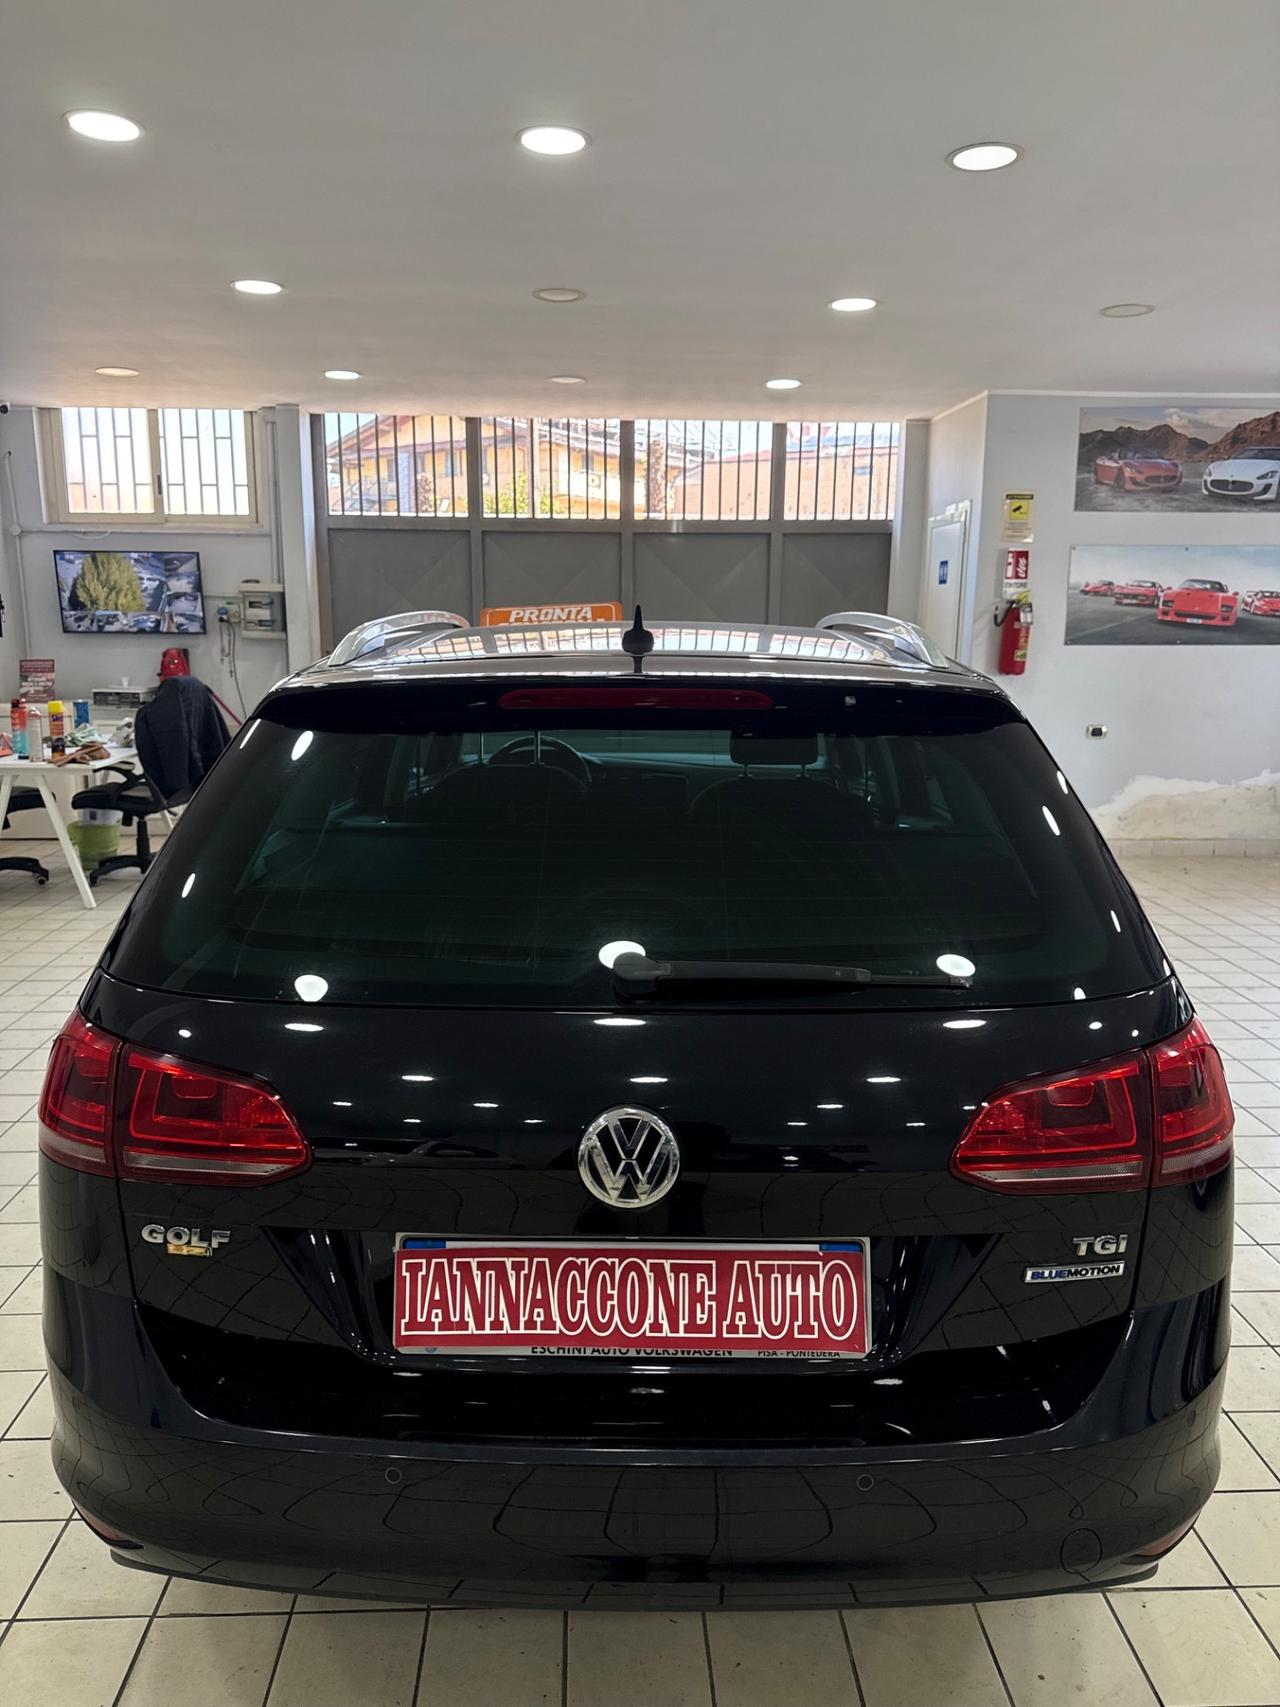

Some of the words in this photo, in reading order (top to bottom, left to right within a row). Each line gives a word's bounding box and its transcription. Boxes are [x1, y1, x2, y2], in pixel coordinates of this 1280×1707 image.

[509, 606, 592, 623] PRONTA
[141, 1224, 231, 1249] GOLF
[1072, 1234, 1128, 1256] TGI
[1030, 1265, 1121, 1280] BLUEMOTION
[401, 1256, 717, 1338] IANNACCONE
[722, 1259, 858, 1341] AUTO
[635, 1348, 733, 1357] VOLKSWAGEN
